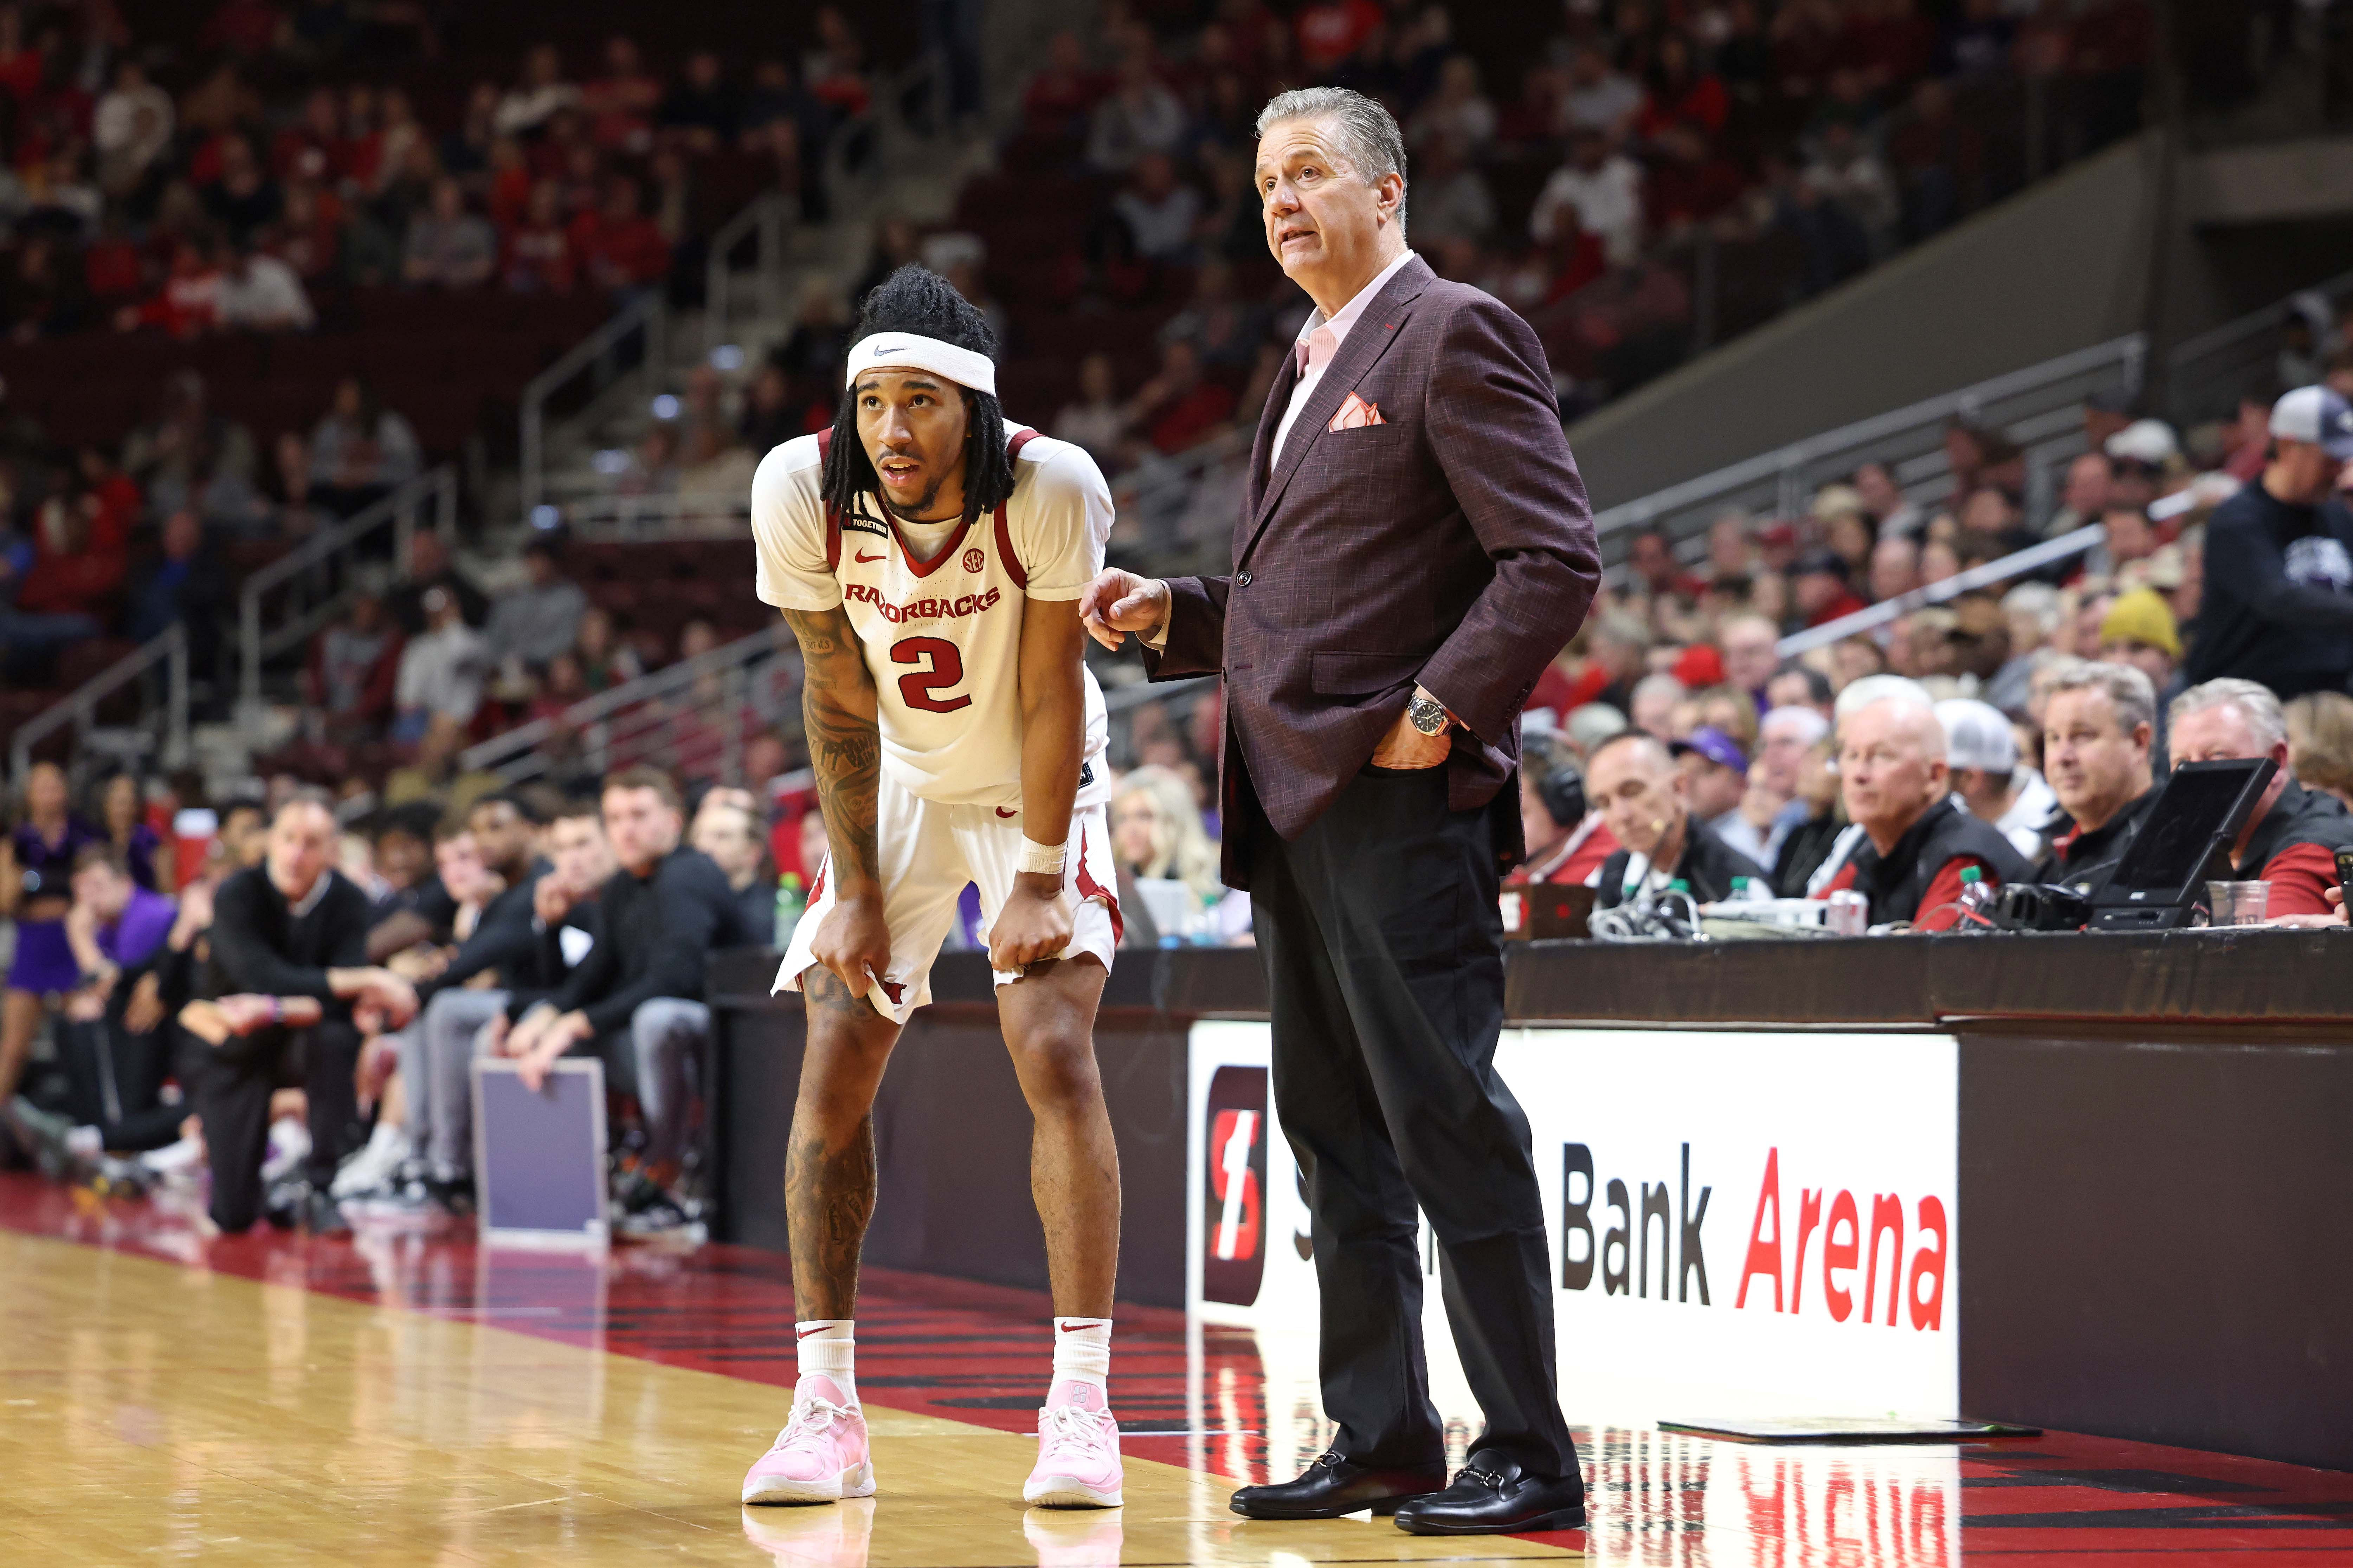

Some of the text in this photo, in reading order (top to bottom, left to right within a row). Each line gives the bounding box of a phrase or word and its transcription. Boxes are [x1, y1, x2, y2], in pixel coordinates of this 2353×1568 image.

[852, 519, 887, 534] TOGETHER
[964, 551, 984, 571] SEC
[890, 636, 972, 713] 2
[1562, 1141, 1712, 1306] Bank
[1734, 1146, 1948, 1331] Arena
